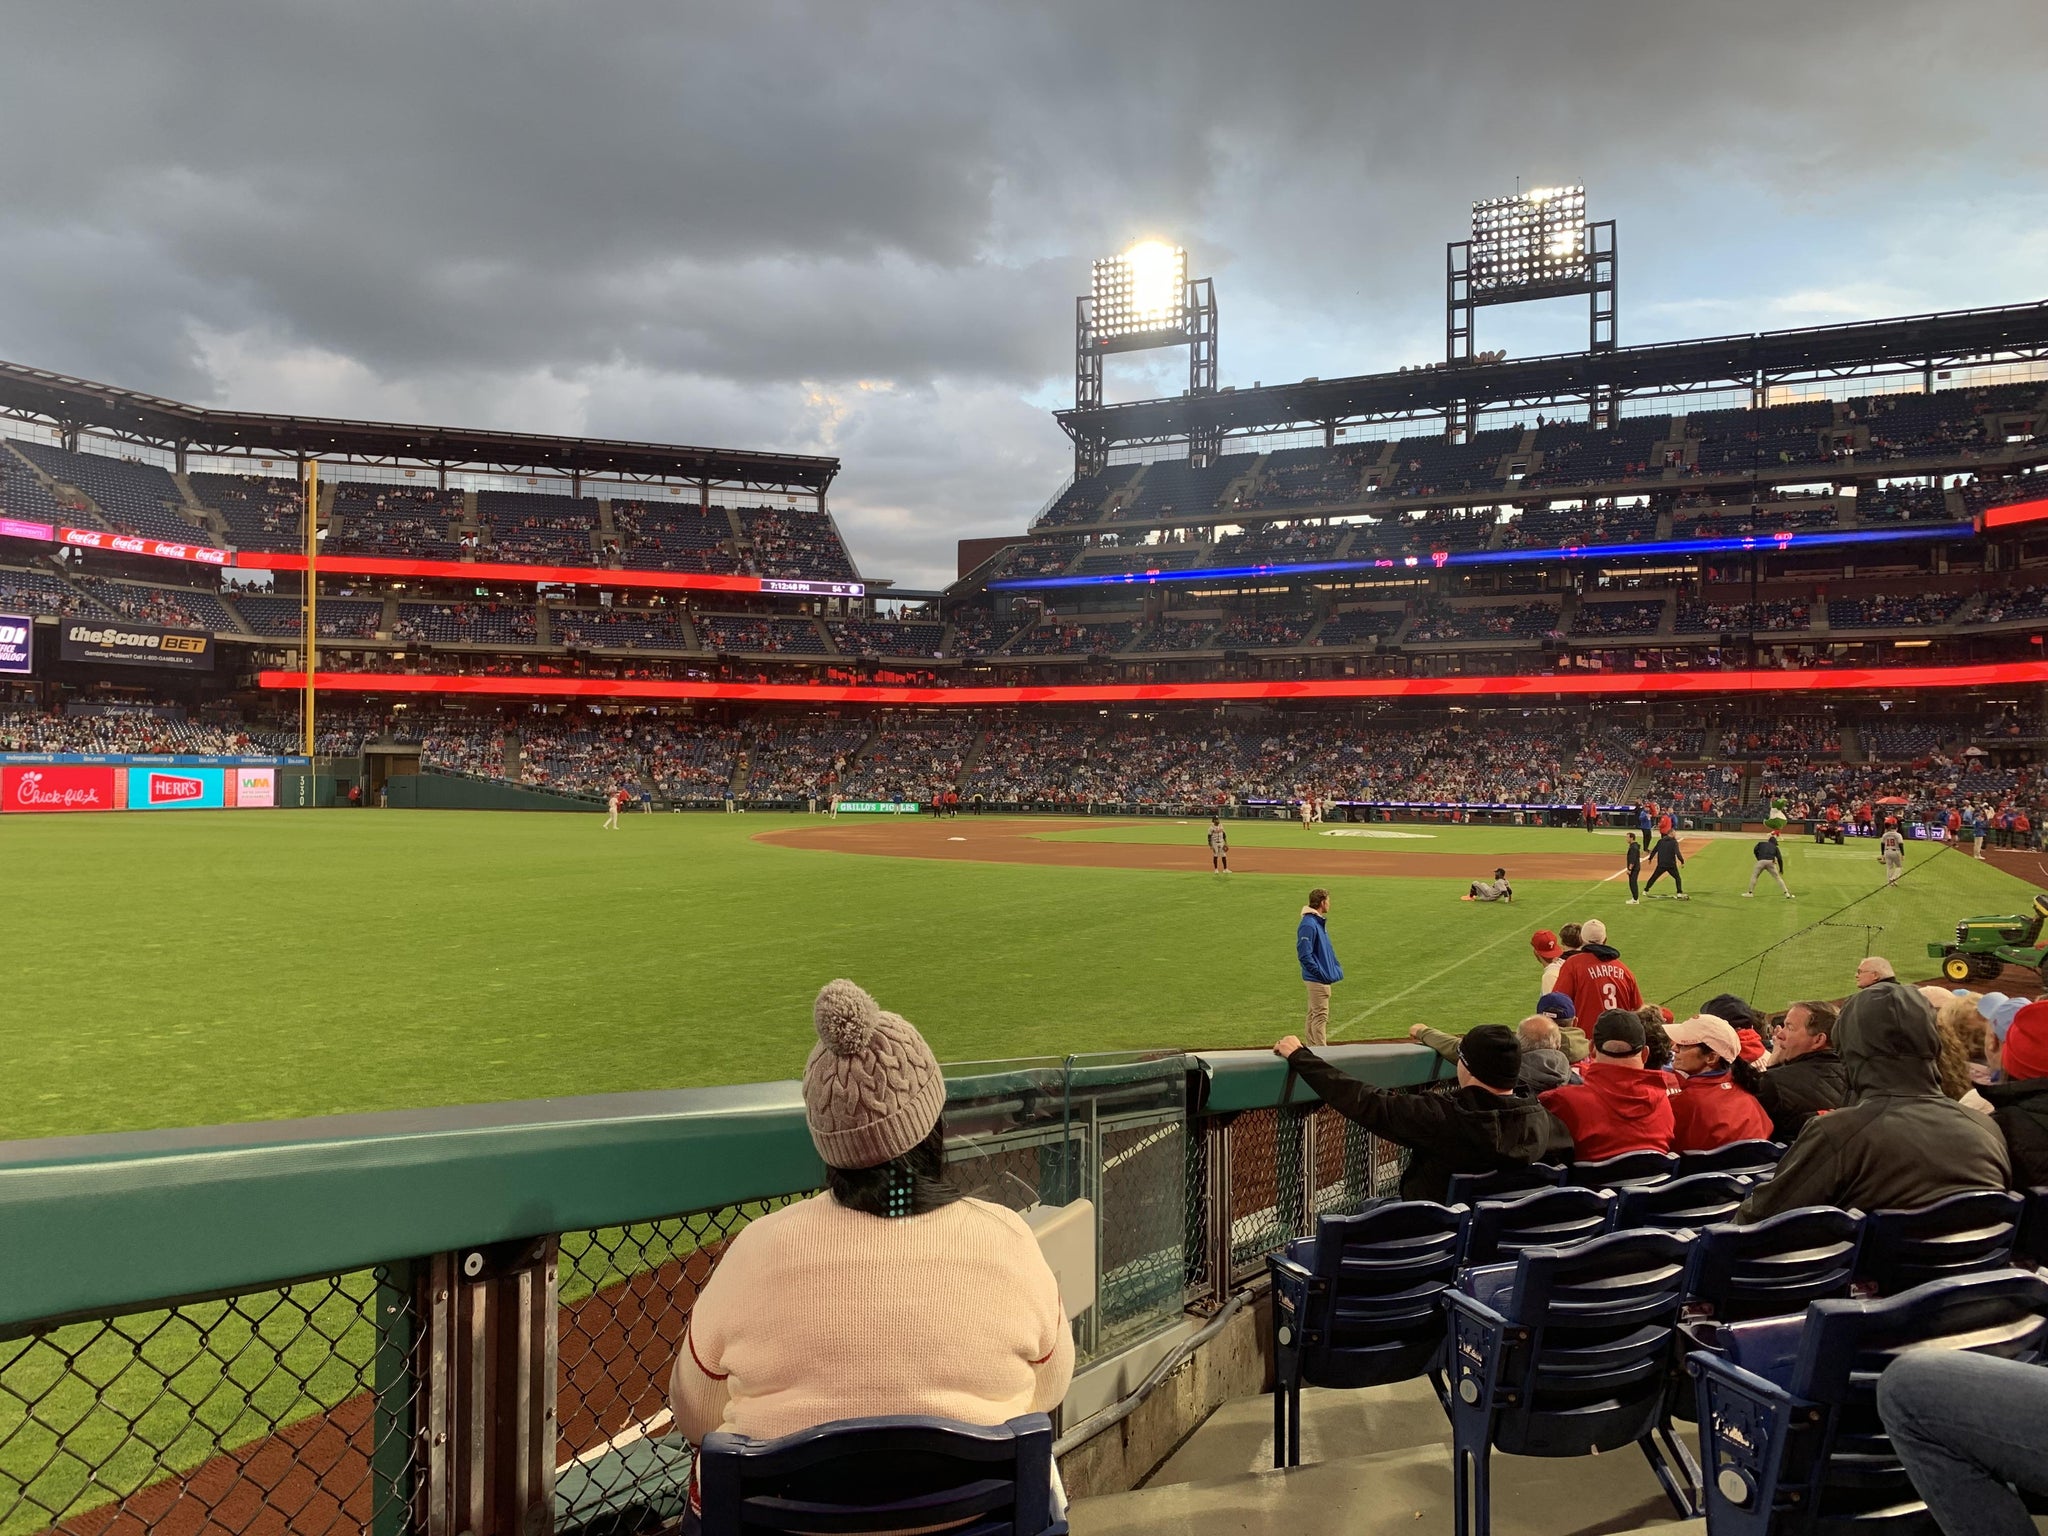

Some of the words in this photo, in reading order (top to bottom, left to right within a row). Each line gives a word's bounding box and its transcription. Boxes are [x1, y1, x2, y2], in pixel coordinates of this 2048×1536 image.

[69, 626, 160, 648] theScore
[164, 637, 203, 649] BET
[84, 650, 109, 658] Gambling
[155, 780, 198, 797] HERR'S
[243, 778, 269, 788] WM
[18, 778, 100, 807] Chick-fil-A
[840, 802, 877, 811] GRILLO'S
[880, 802, 916, 811] PICLES
[1587, 964, 1625, 980] HARPER
[1602, 983, 1618, 1011] 3
